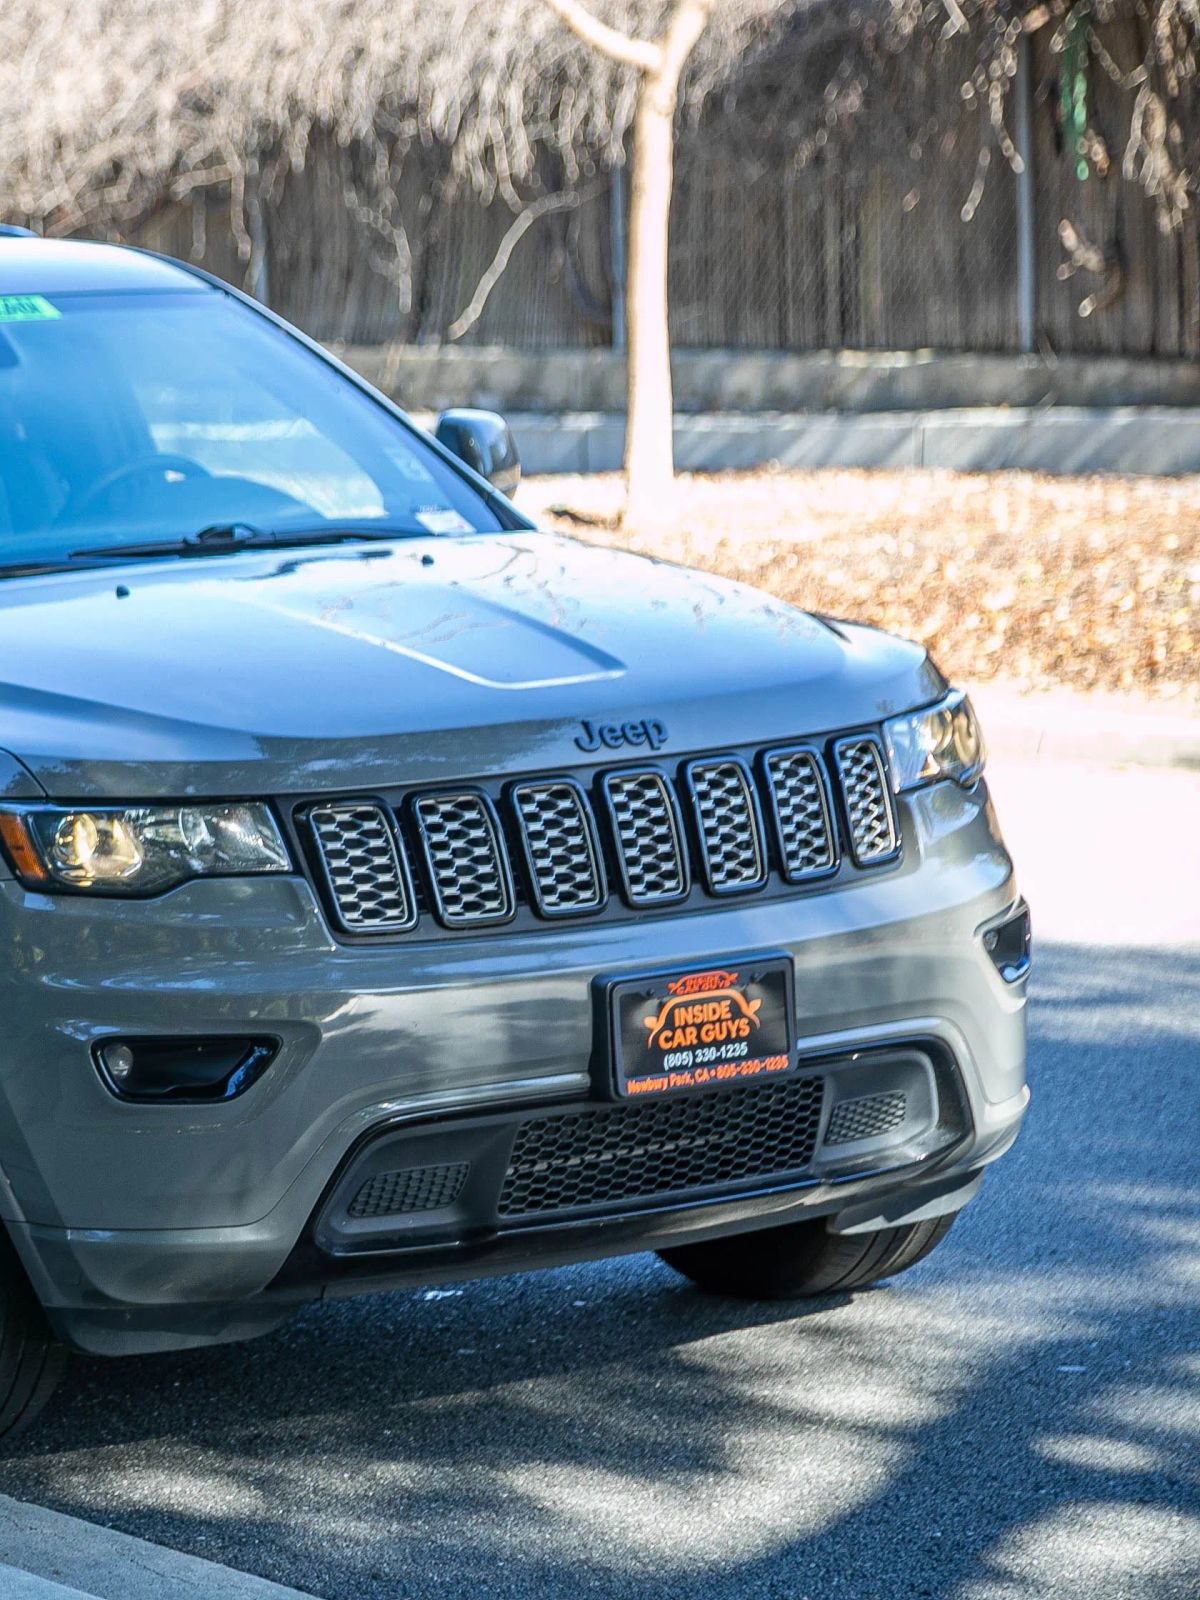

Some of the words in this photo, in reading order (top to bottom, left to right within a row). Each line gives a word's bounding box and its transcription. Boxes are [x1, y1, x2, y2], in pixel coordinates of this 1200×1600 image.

[574, 719, 668, 752] Jeep
[673, 1000, 732, 1026] INSIDE
[658, 1026, 698, 1050] CAR
[700, 1018, 750, 1041] GUYS
[663, 1050, 693, 1070] (805)
[695, 1042, 748, 1064] 330-1235
